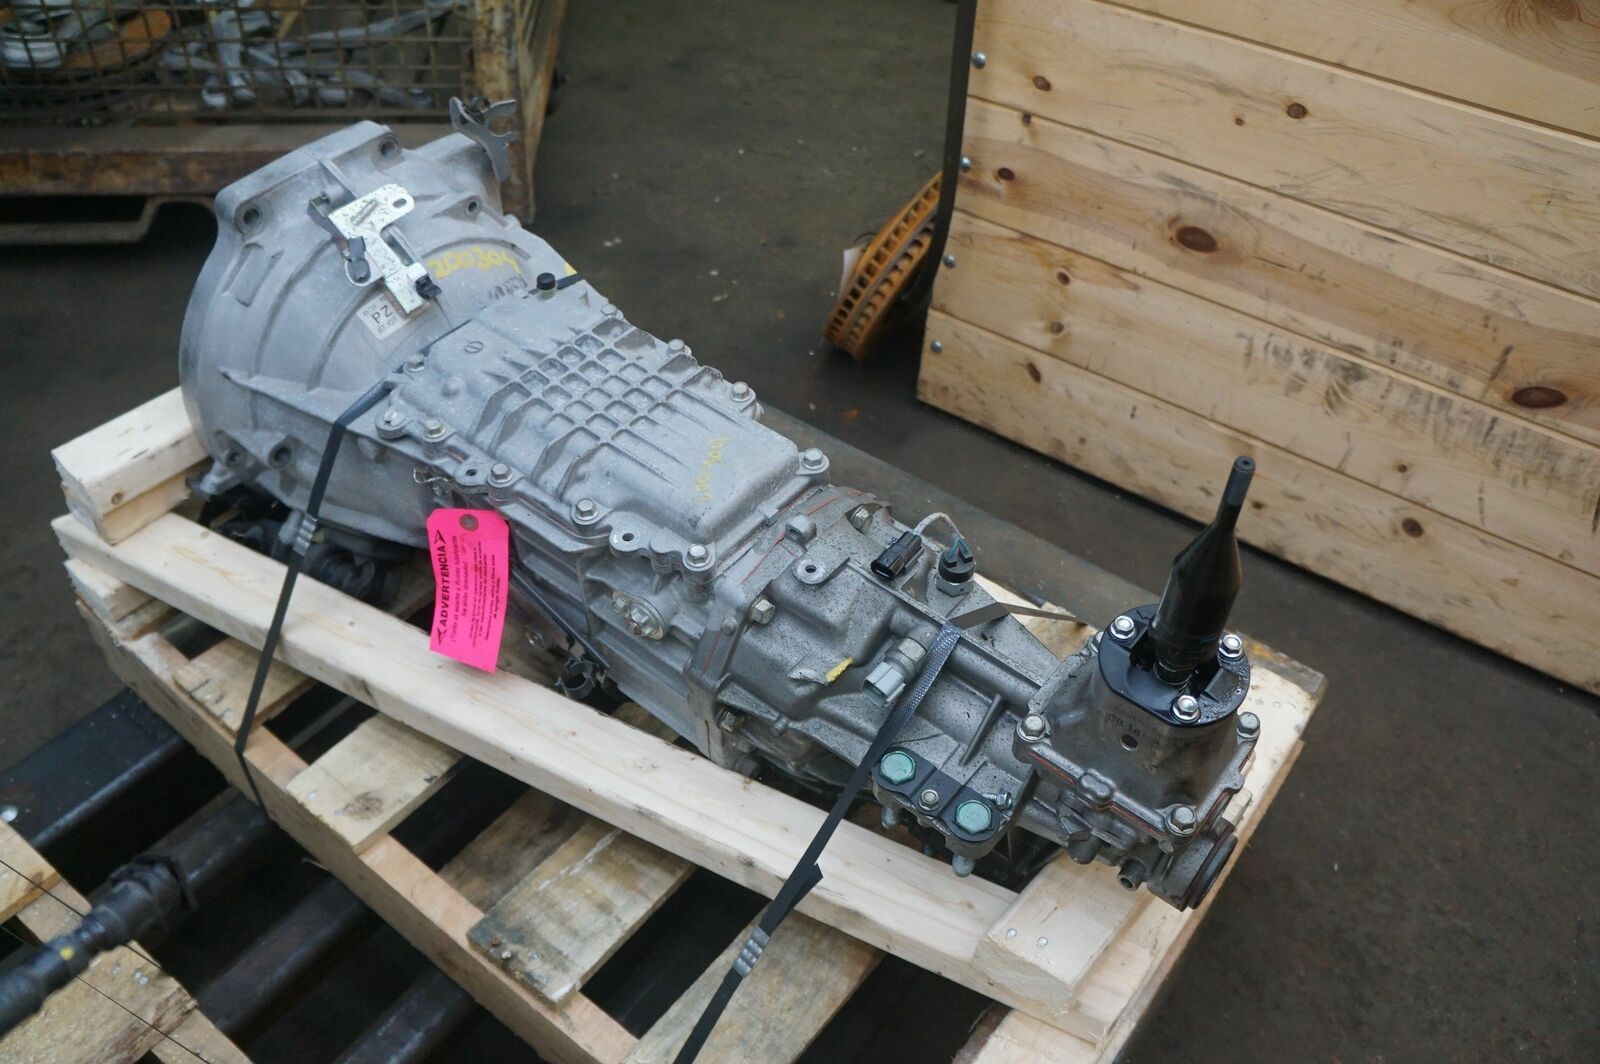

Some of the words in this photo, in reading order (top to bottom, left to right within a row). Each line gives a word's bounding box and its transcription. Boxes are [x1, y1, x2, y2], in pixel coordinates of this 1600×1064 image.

[427, 247, 521, 278] 200304
[371, 304, 395, 324] PZ
[437, 546, 450, 627] ADVERTENCIA
